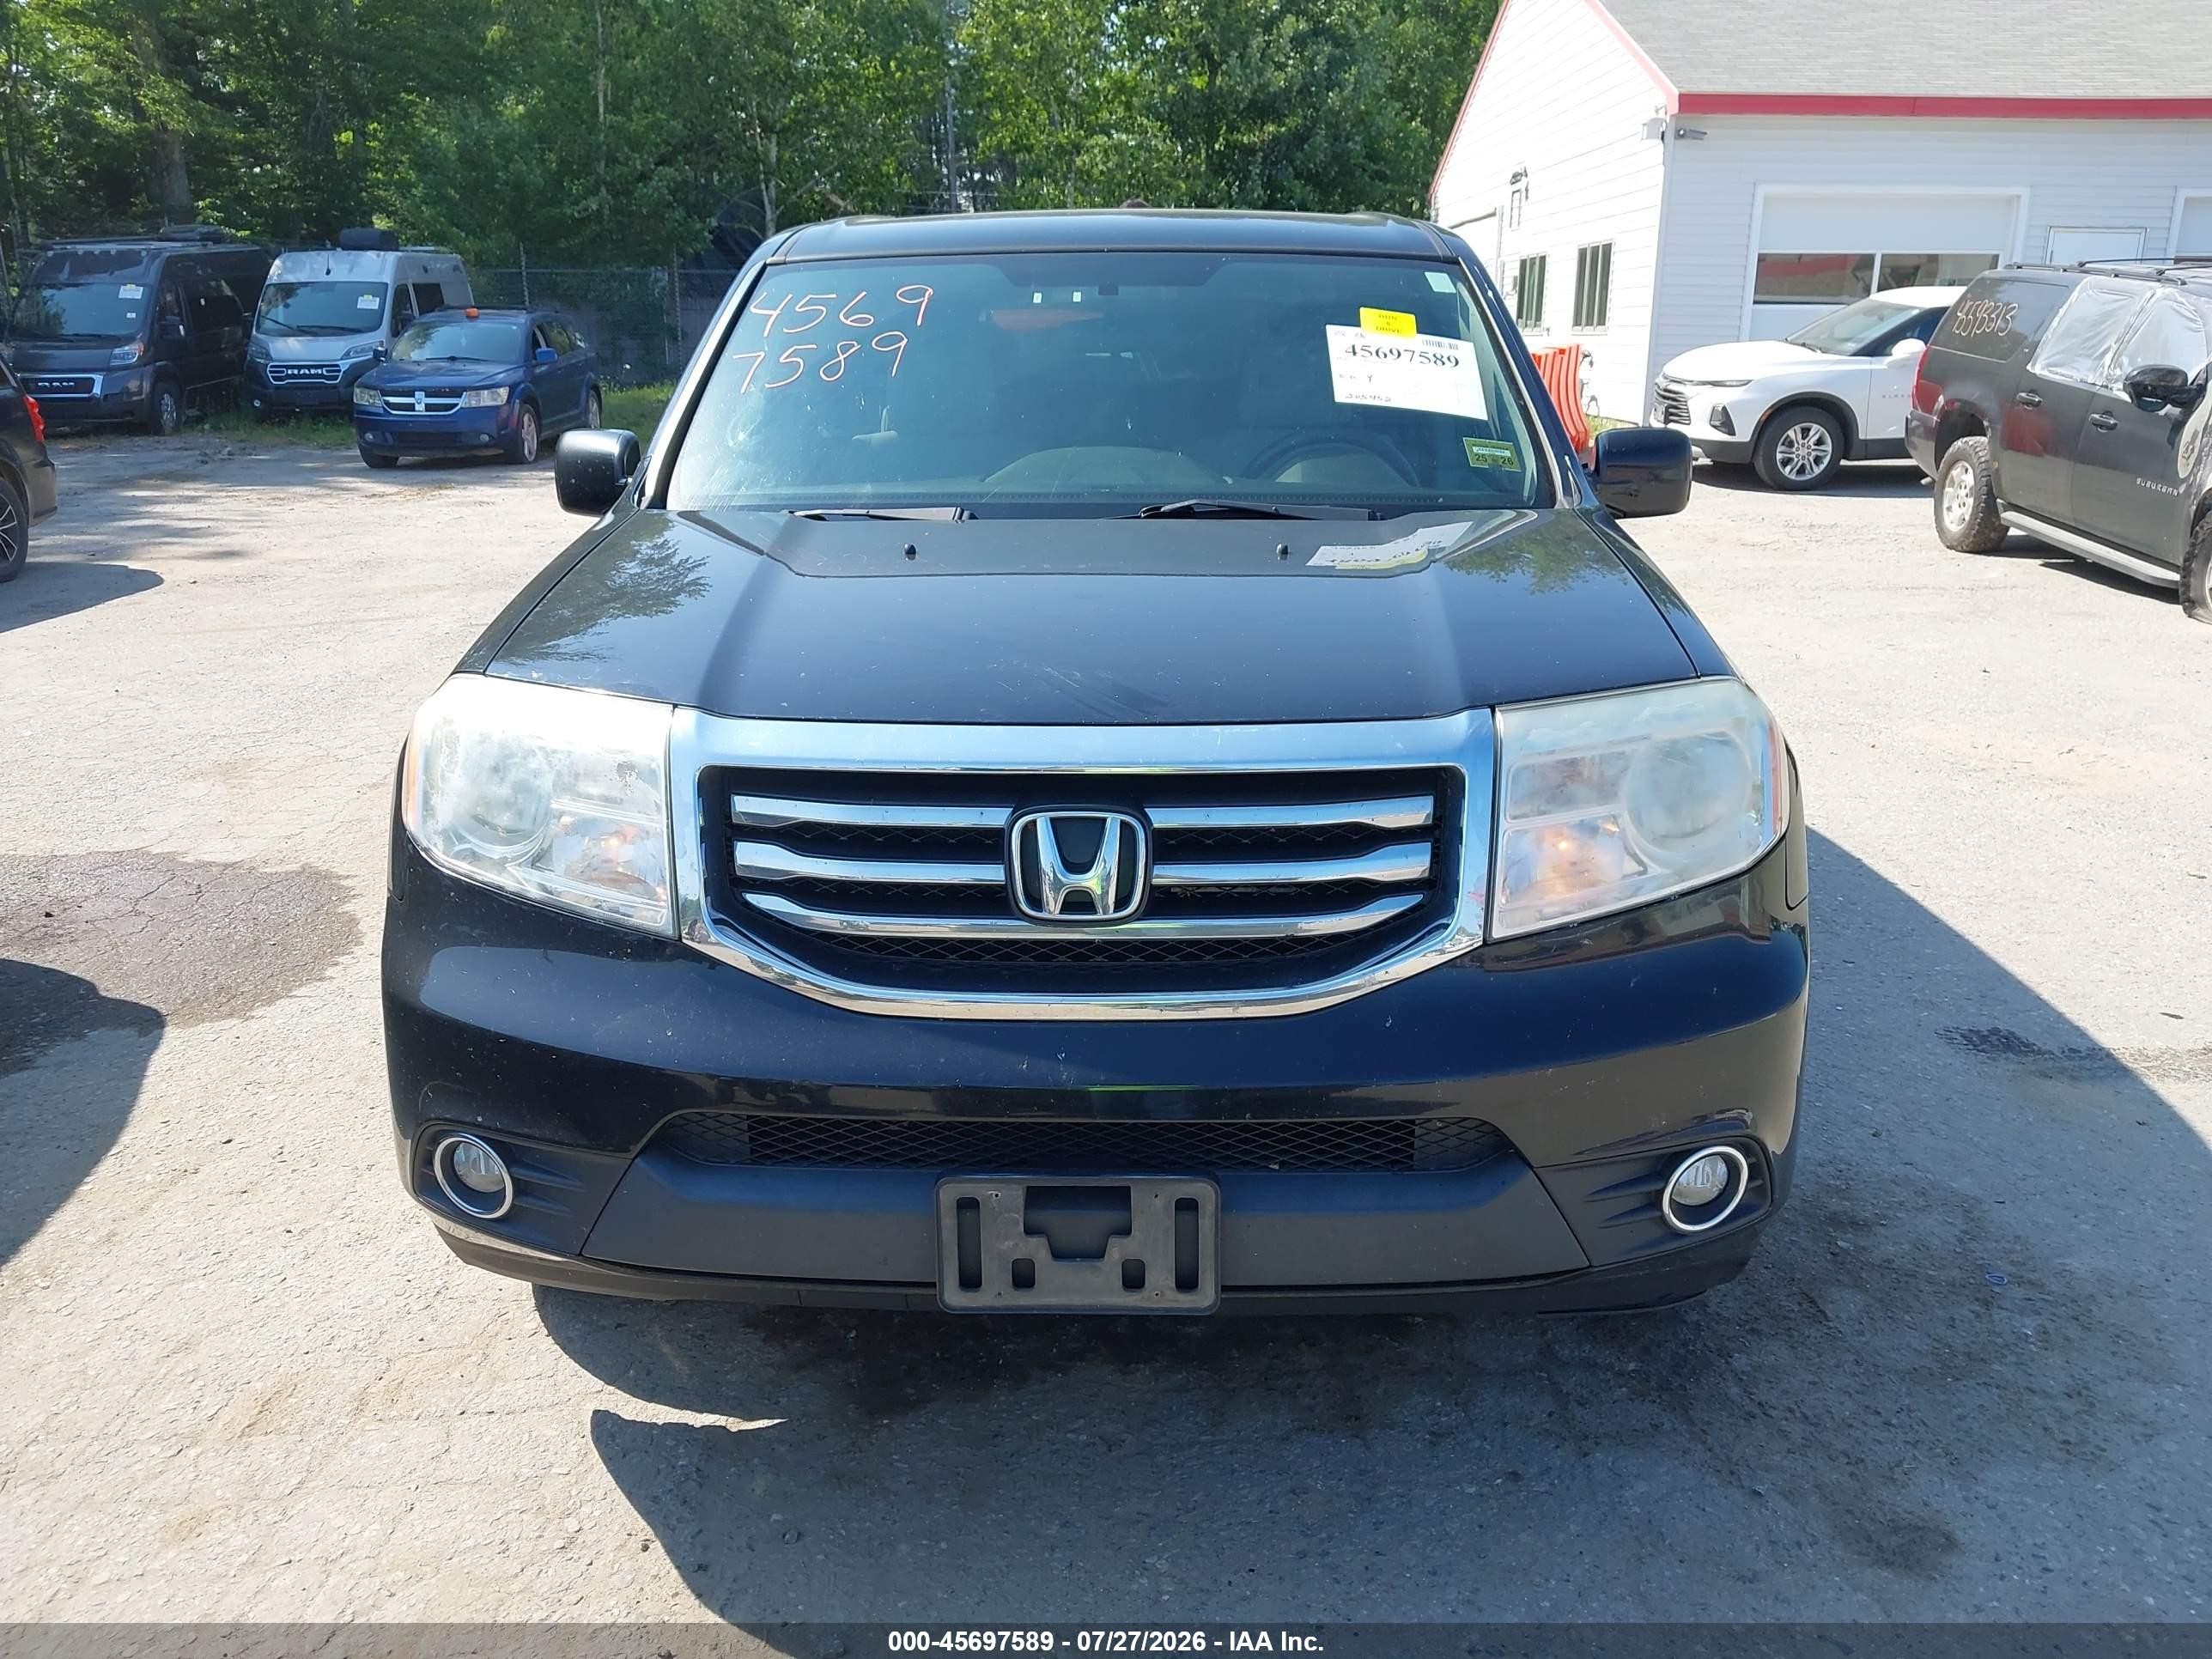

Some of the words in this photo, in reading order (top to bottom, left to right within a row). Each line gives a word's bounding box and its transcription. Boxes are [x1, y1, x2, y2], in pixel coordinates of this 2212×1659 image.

[750, 284, 934, 337] 4569
[732, 331, 908, 394] 7589
[1345, 343, 1460, 368] 45697589
[1474, 453, 1487, 463] 25
